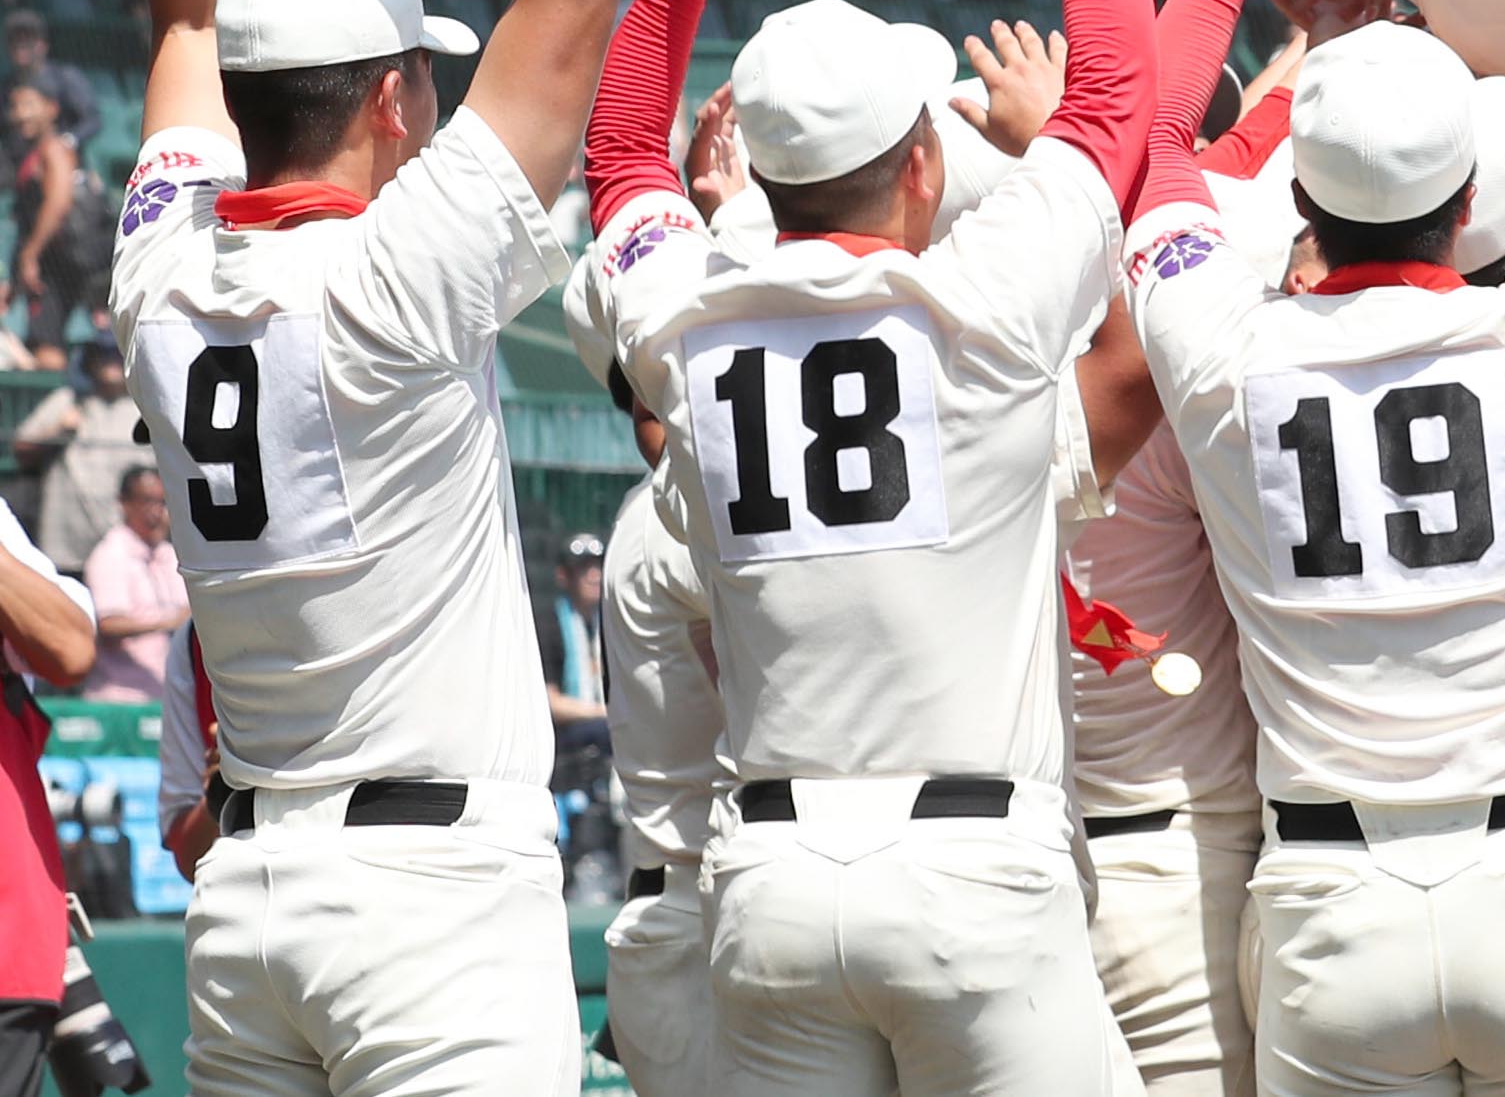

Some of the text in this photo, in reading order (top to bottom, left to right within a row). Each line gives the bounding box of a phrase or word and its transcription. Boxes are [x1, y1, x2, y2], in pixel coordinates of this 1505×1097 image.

[182, 345, 269, 542] 9
[714, 337, 911, 536] 18
[1278, 381, 1496, 579] 19
